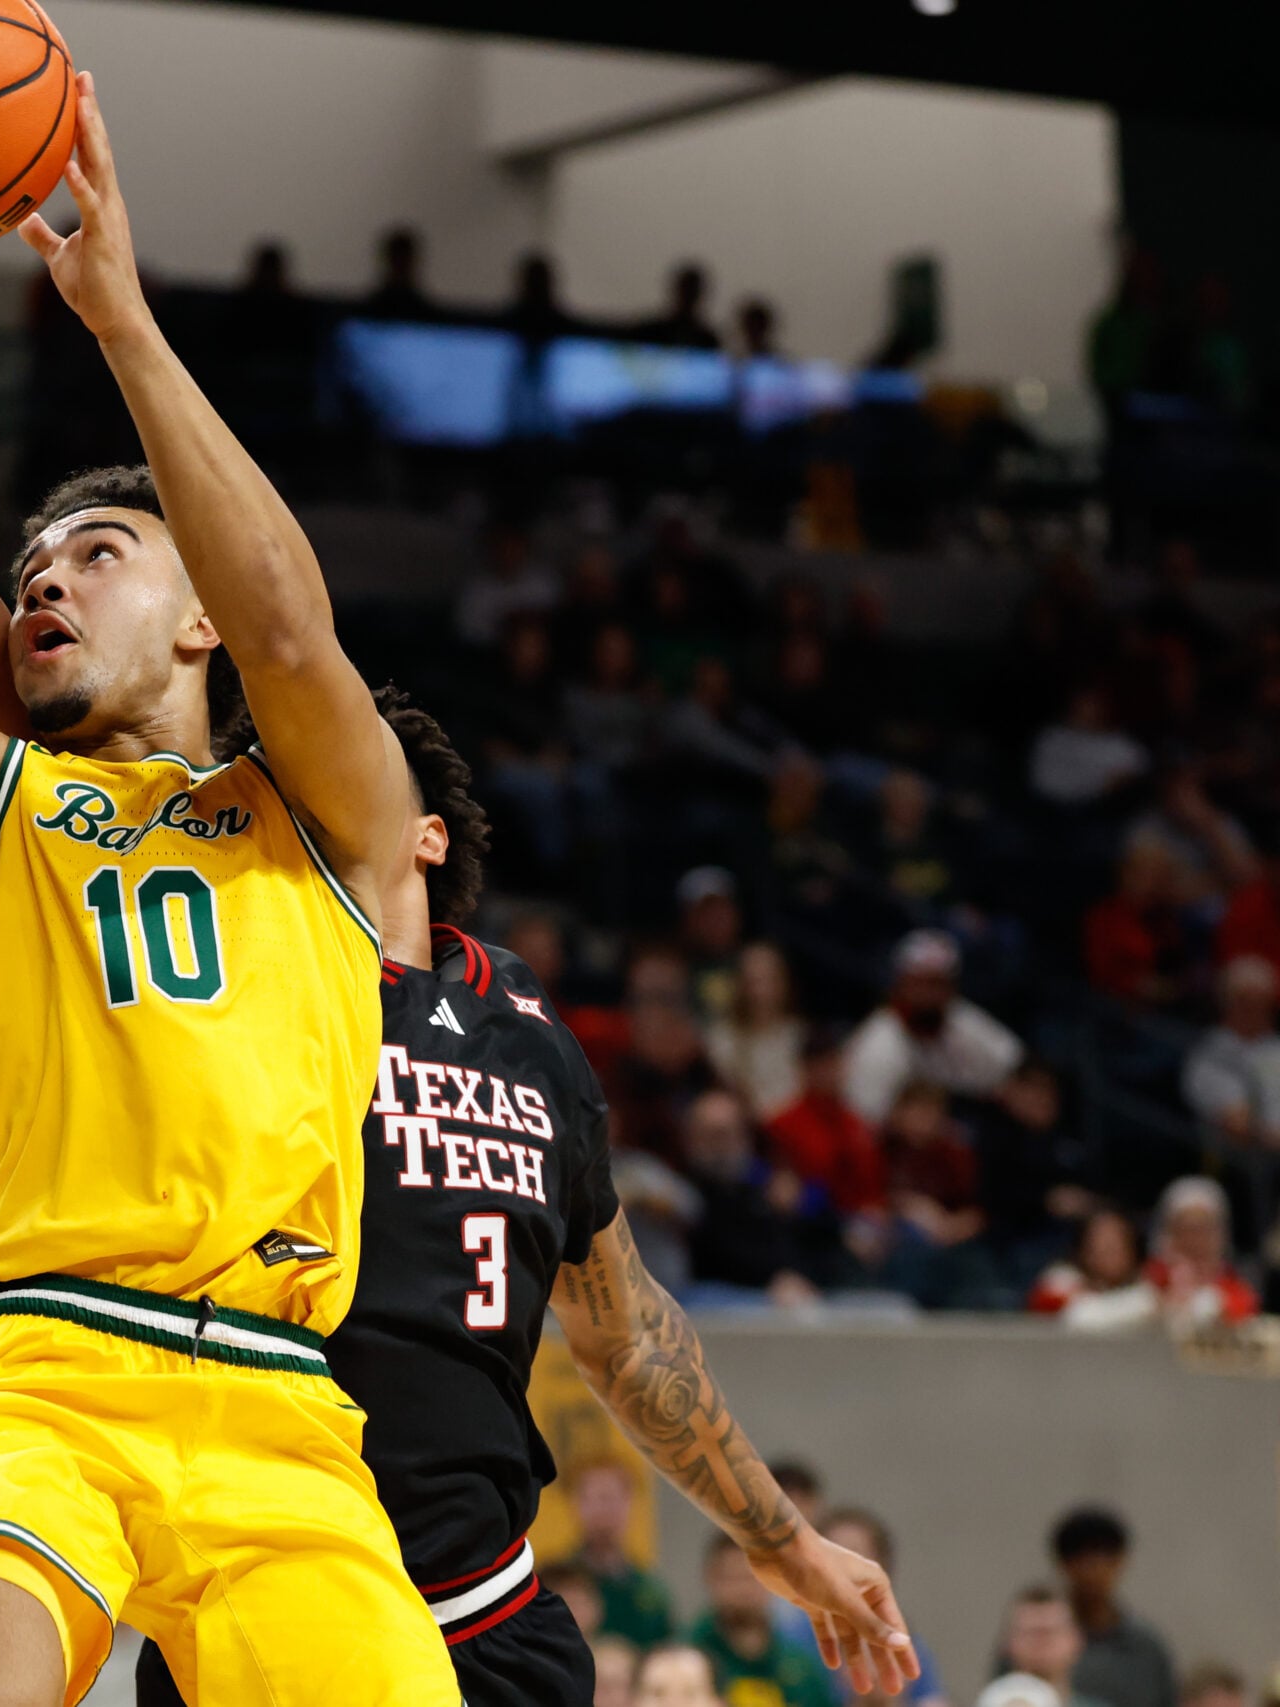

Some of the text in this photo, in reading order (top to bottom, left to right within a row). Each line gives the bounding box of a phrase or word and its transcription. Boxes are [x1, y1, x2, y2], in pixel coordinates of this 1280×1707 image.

[34, 781, 253, 857] Baylor
[83, 865, 226, 1010] 10
[373, 1043, 554, 1142] TEXAS
[384, 1114, 547, 1205] TECH
[461, 1212, 508, 1330] 3
